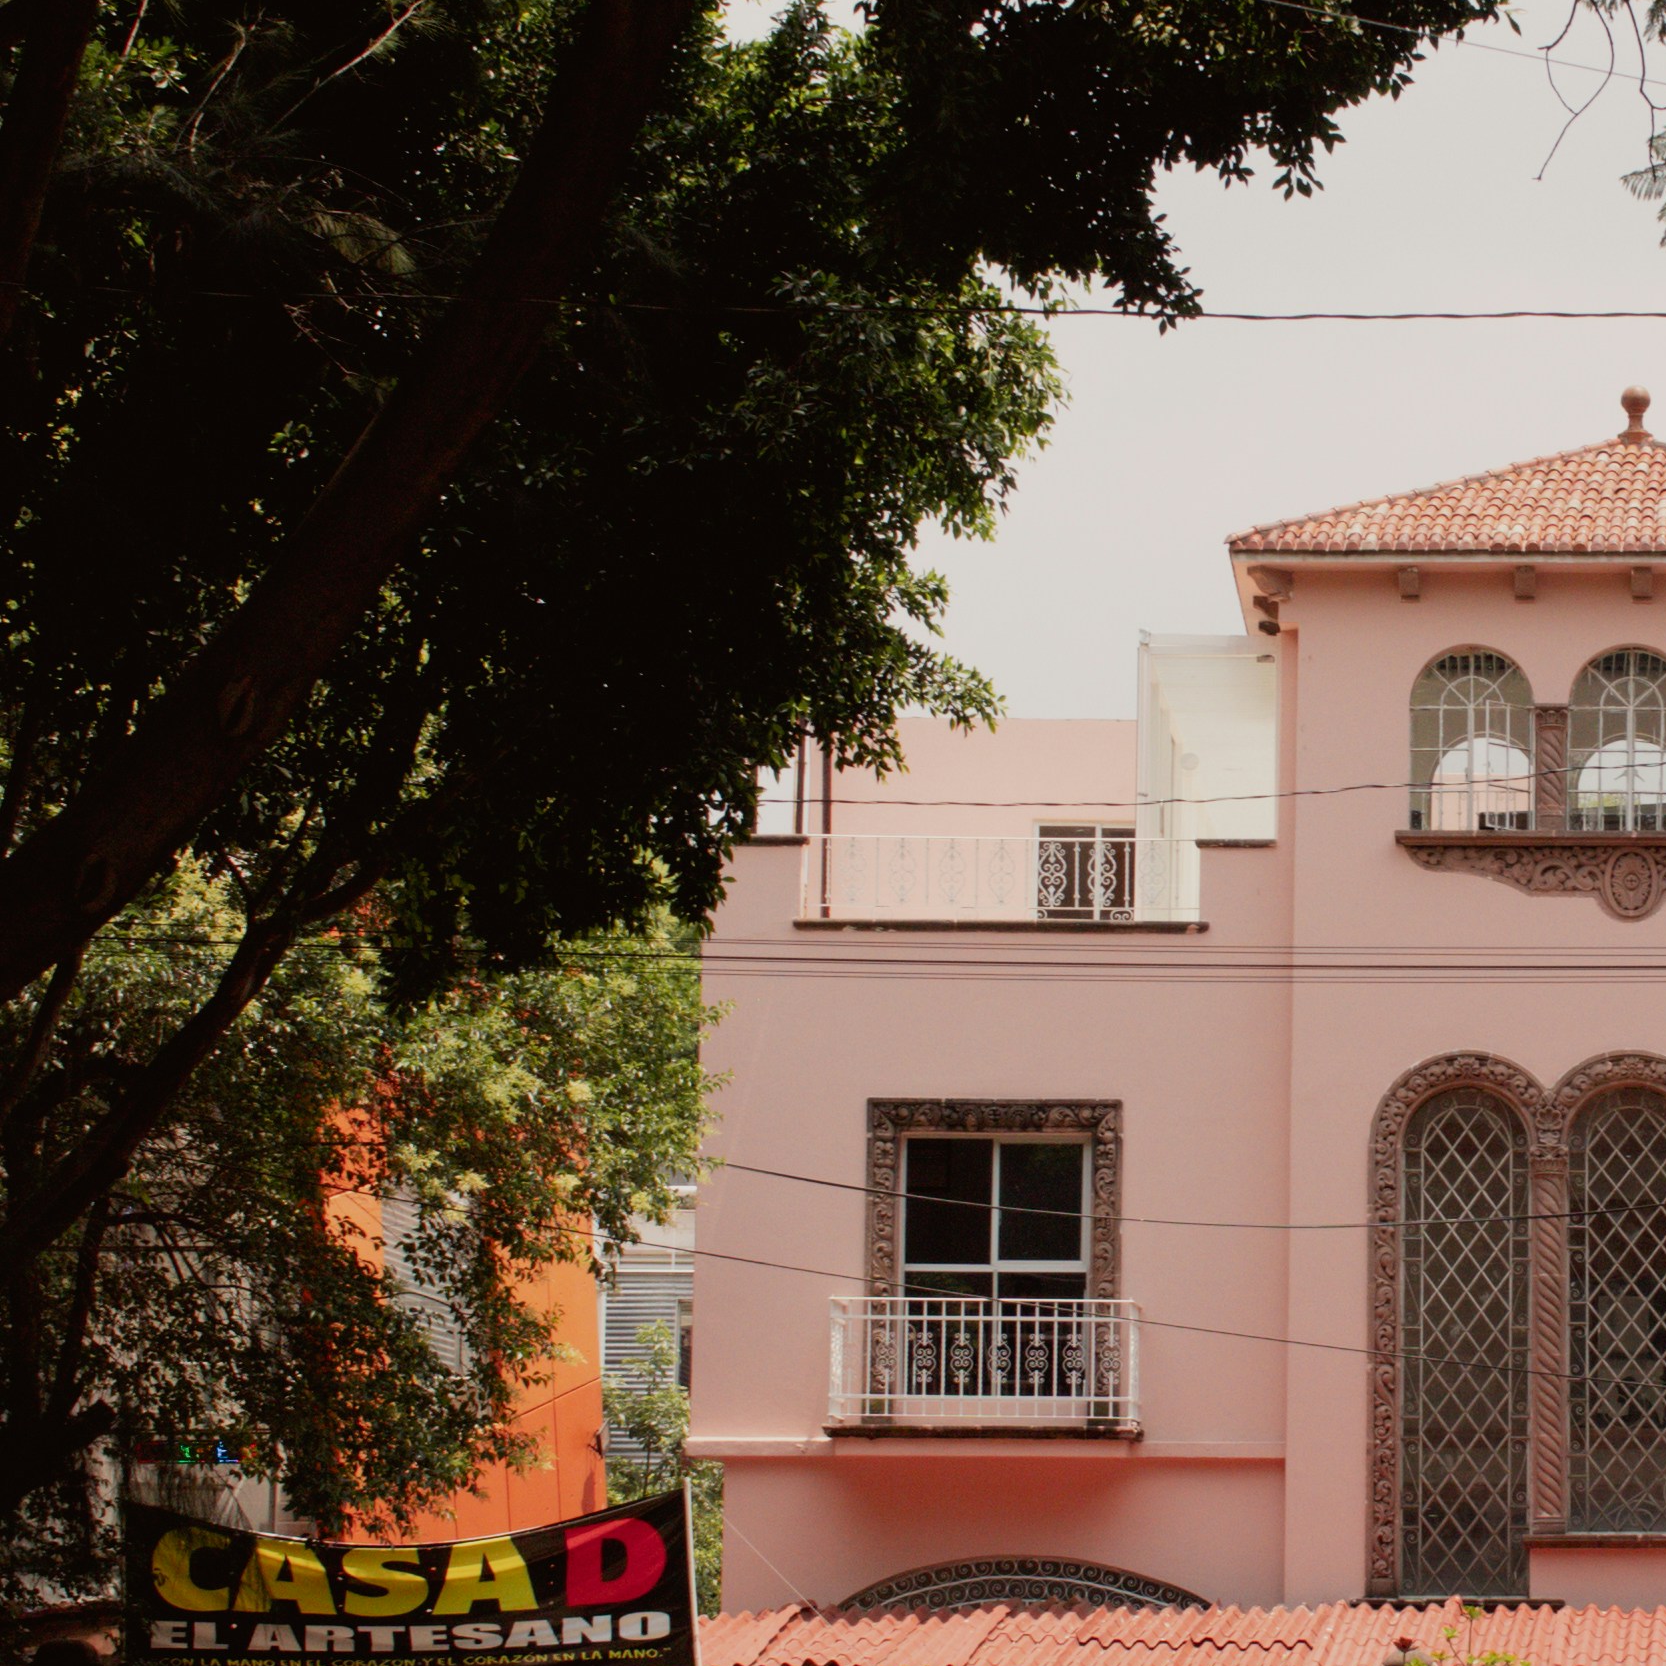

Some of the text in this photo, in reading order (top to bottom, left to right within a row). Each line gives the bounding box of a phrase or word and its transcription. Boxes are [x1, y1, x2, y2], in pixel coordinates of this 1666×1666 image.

[151, 1517, 668, 1618] CASA D
[150, 1610, 671, 1653] EL ARTESANO
[436, 1656, 457, 1666] EL
[462, 1651, 549, 1666] CORAZÓN
[552, 1651, 576, 1663] EN
[581, 1649, 603, 1661] LA
